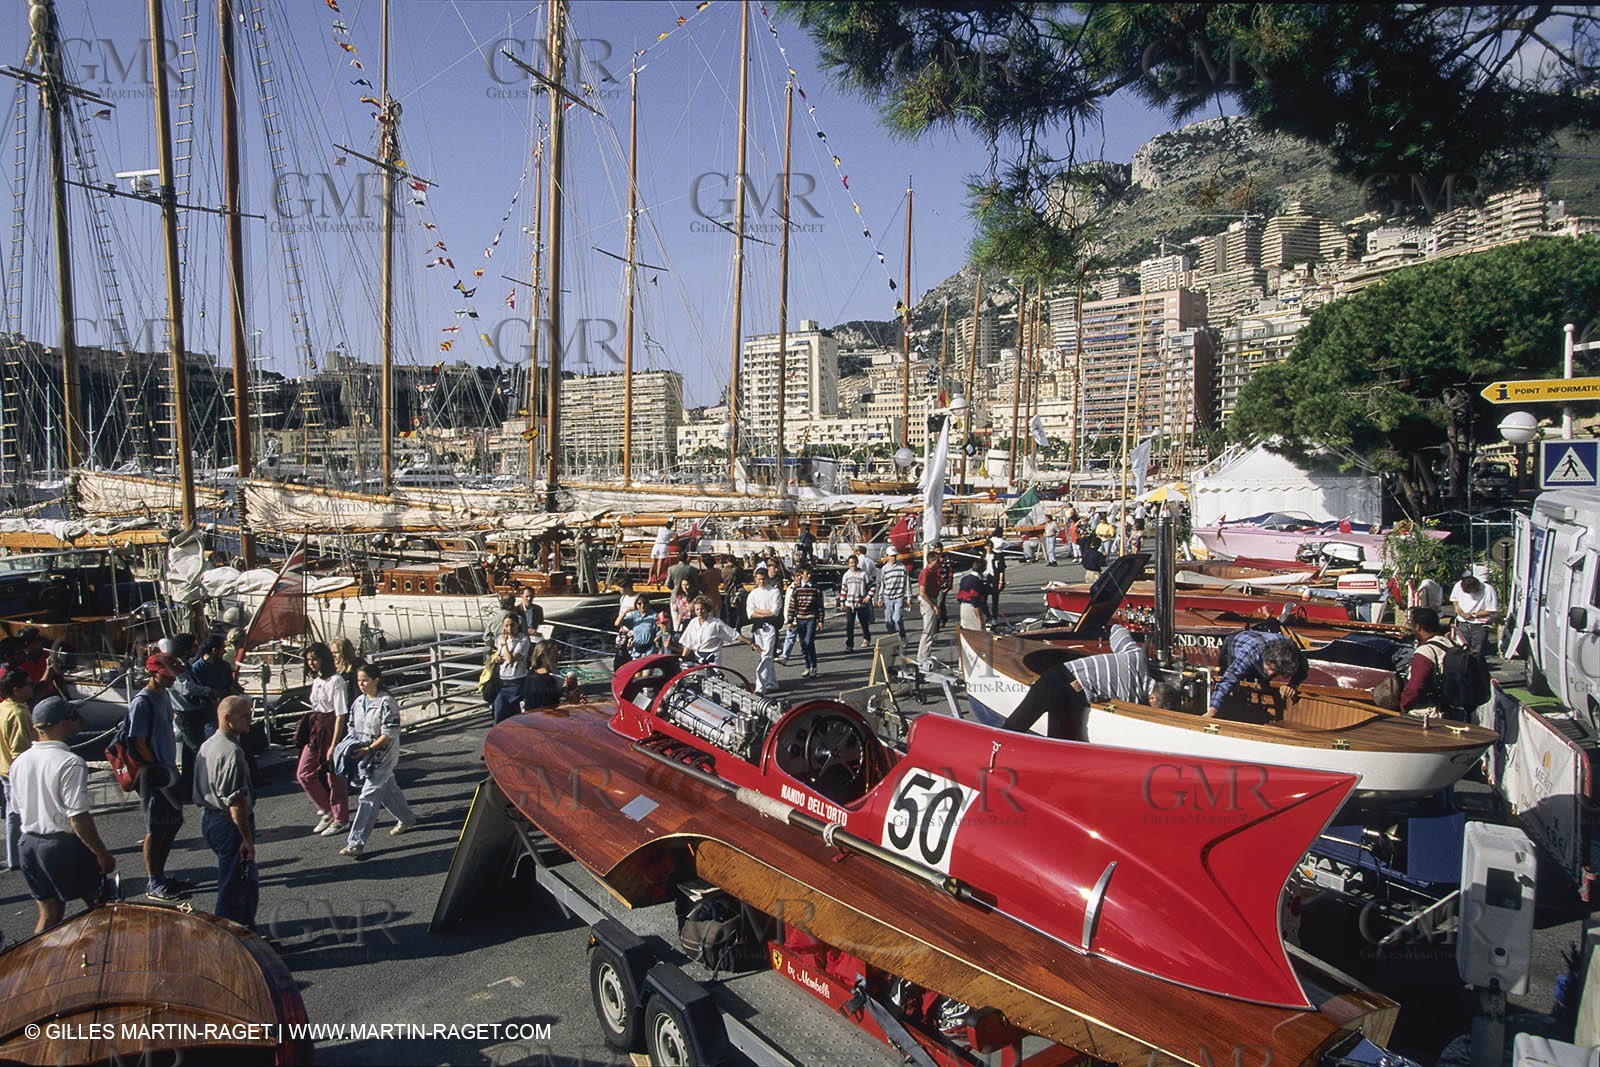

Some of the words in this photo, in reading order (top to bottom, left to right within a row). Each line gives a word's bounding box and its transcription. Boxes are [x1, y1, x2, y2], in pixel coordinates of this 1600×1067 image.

[781, 784, 806, 807] NANDO
[807, 796, 848, 827] DELL'ORTO
[887, 774, 964, 865] 50
